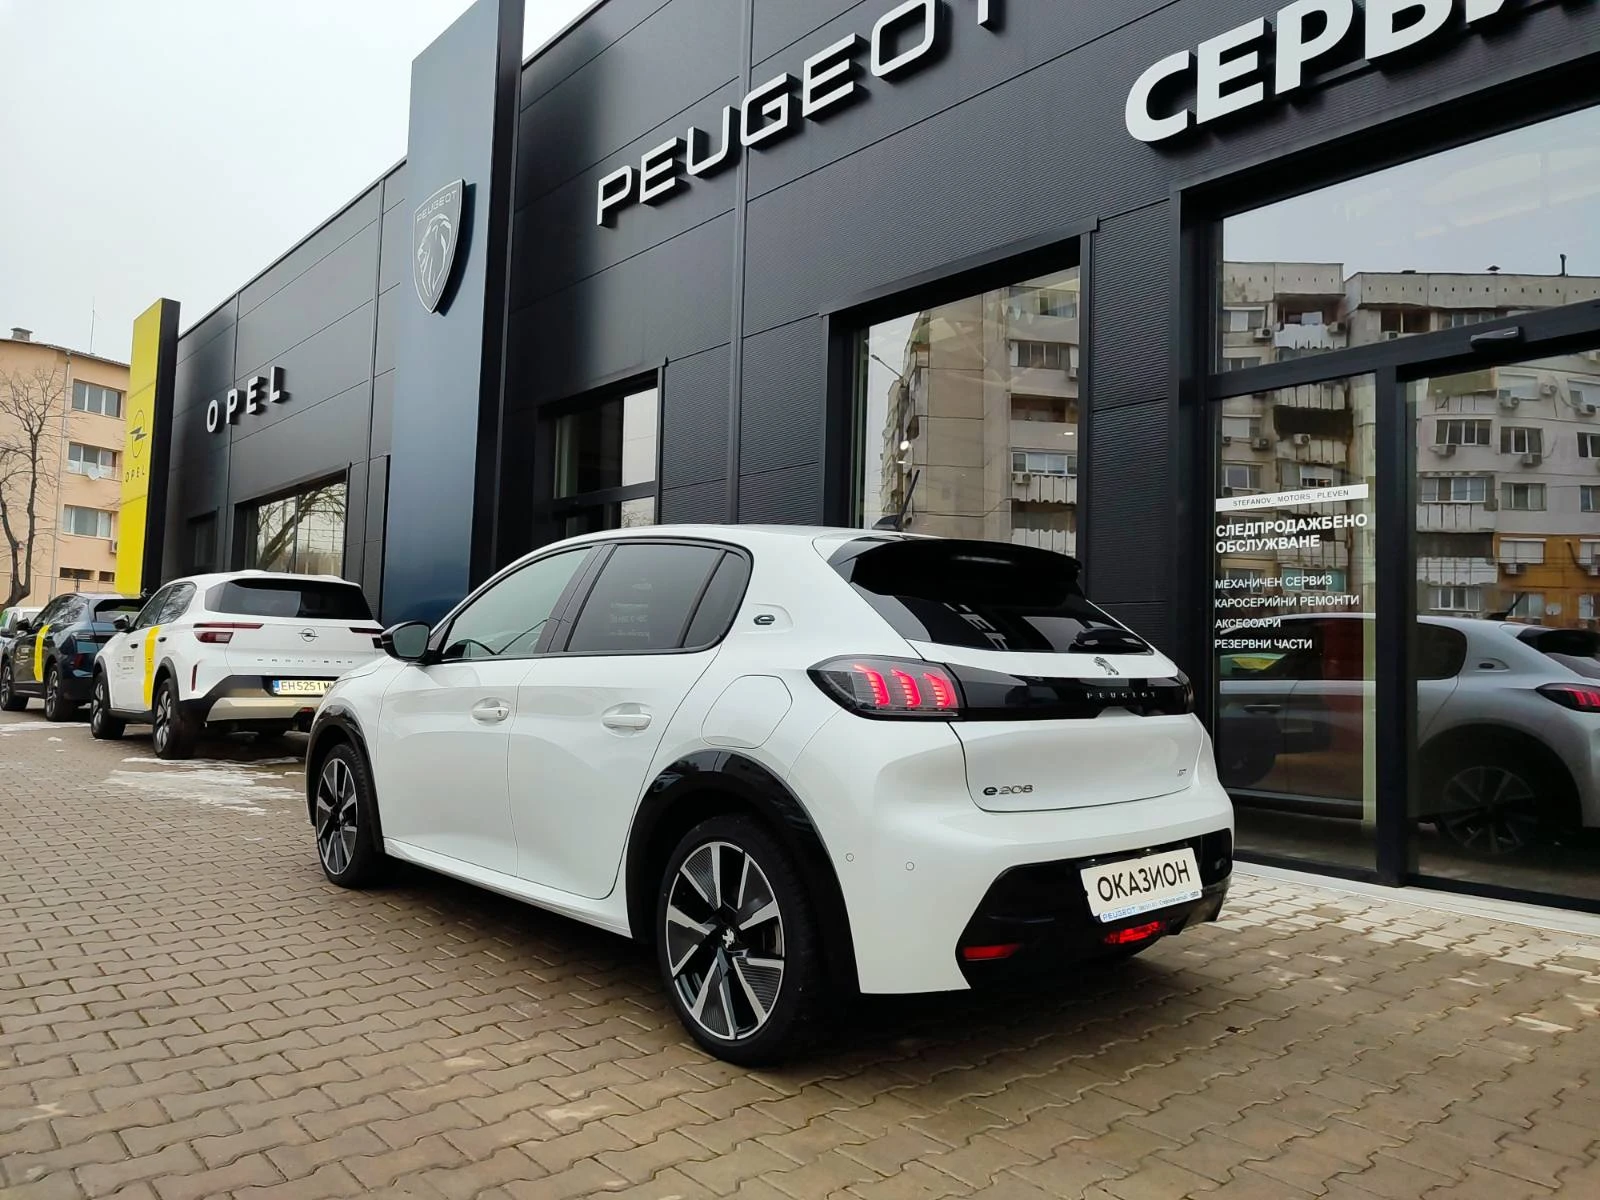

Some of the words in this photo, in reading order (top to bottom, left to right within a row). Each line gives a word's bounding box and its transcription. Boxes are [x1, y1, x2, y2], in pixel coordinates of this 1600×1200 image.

[1125, 0, 1507, 143] СЕРВ
[416, 189, 457, 224] PEUGEOT
[206, 365, 281, 433] OPEL
[125, 465, 146, 483] OPEL
[1316, 489, 1349, 499] PLEVEN
[1215, 513, 1368, 537] СЛЕДПРОДАЖБЕНО
[1215, 535, 1321, 553] ОБСЛУЖВАНЕ
[1215, 577, 1282, 589] МЕХАНИЧЕН
[1285, 575, 1333, 586] СЕРВИЗ
[1215, 595, 1297, 608] КАРОСЕРИЙНИ
[1299, 594, 1360, 606] РЕМОНТИ
[1215, 618, 1281, 629] АКСЕСОАРИ
[1214, 639, 1271, 649] РЕЗЕРВНИ
[1274, 639, 1313, 649] ЧАСТИ
[1096, 859, 1191, 902] ОКАЗИОН
[1102, 906, 1137, 920] PEUGEOT
